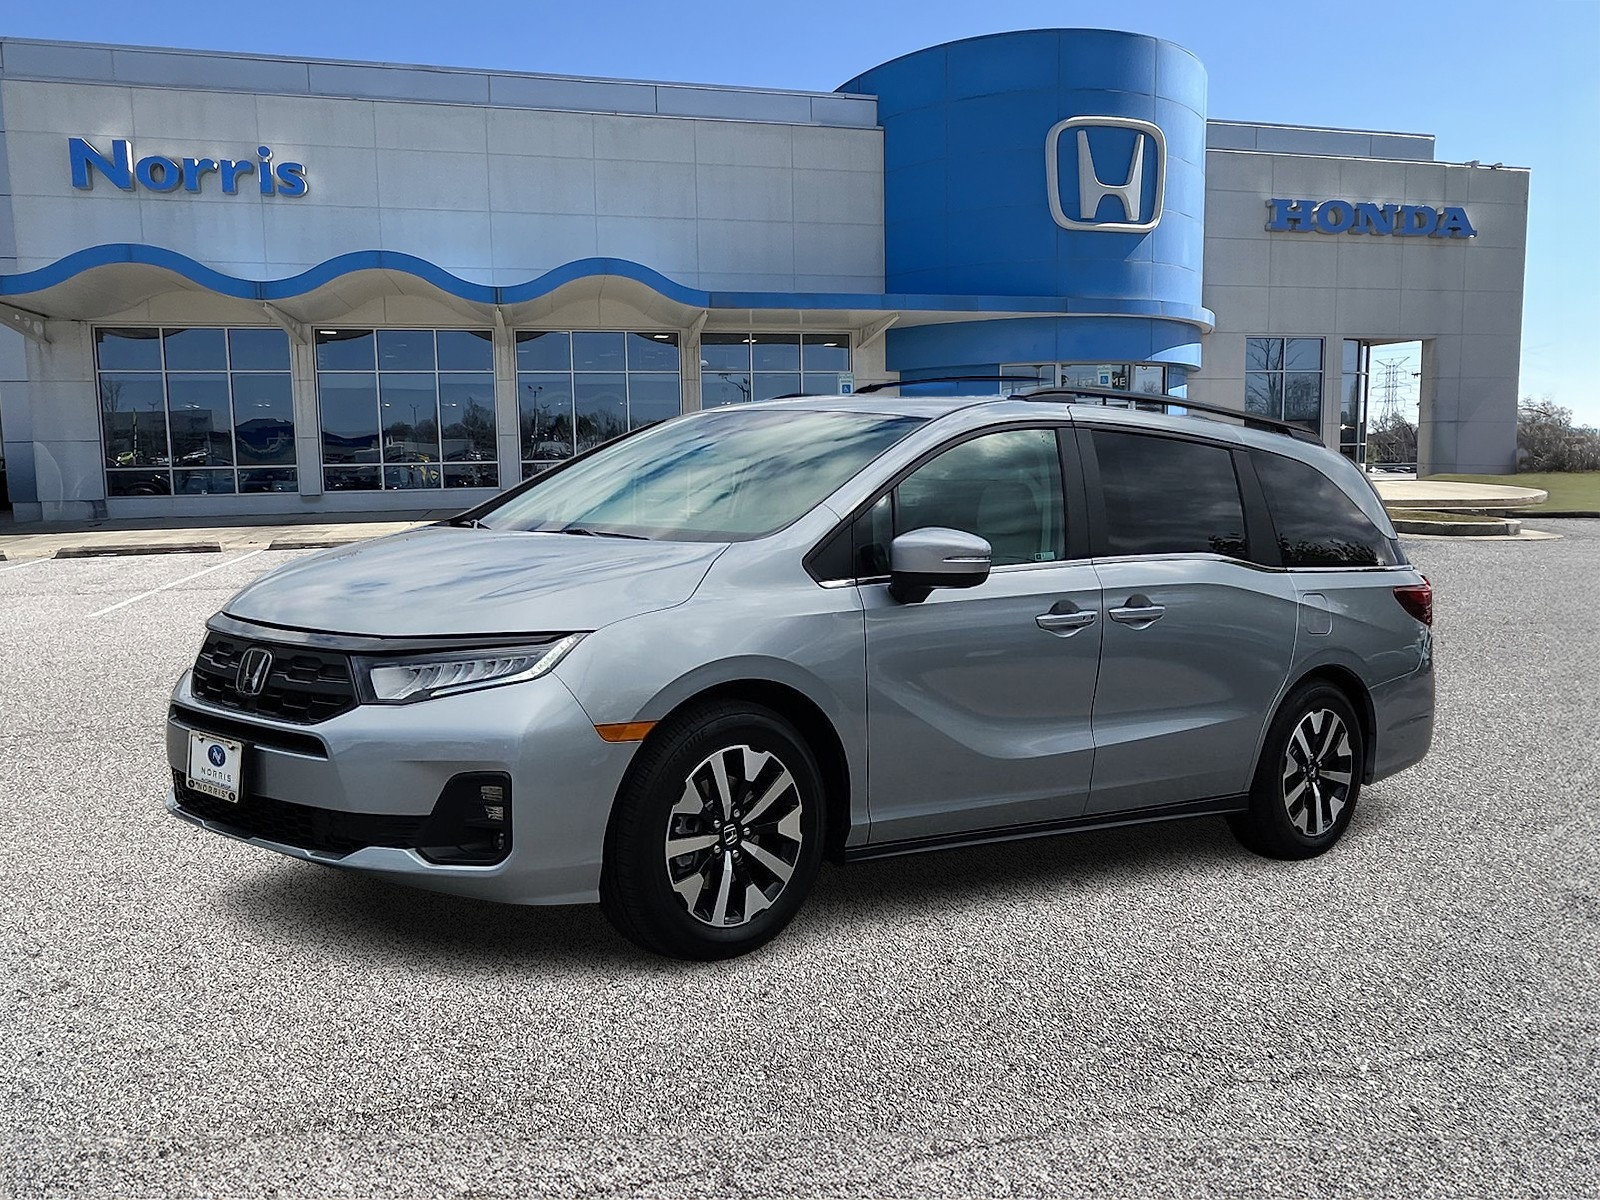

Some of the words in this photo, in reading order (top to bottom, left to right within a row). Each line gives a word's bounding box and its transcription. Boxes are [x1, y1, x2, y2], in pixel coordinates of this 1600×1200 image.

[69, 138, 309, 197] Norris
[1265, 198, 1477, 239] HONDA
[201, 767, 232, 782] NORRIS
